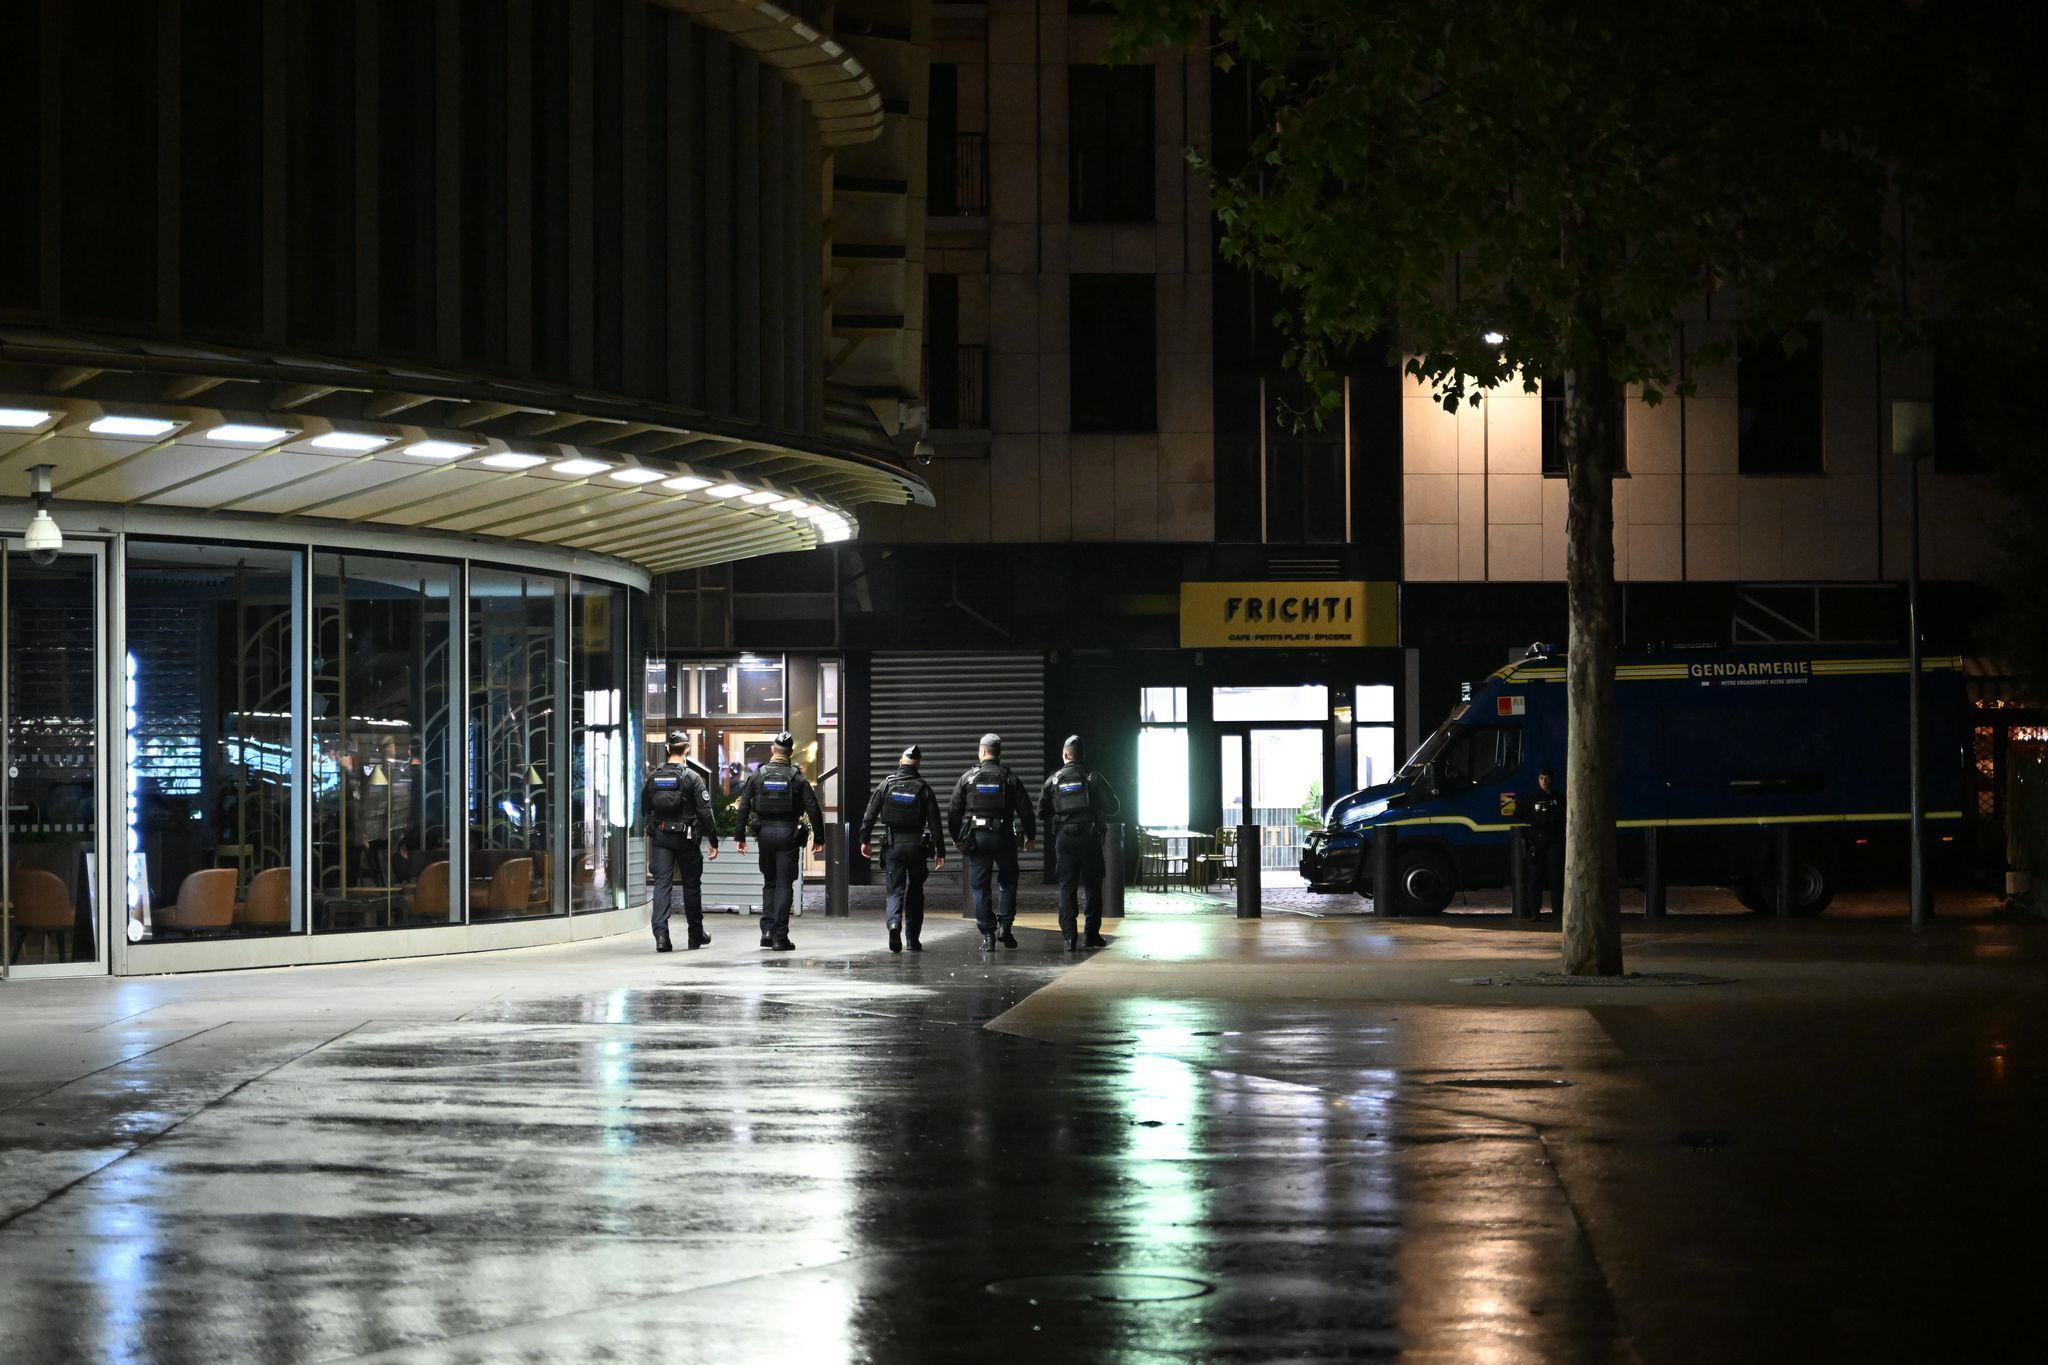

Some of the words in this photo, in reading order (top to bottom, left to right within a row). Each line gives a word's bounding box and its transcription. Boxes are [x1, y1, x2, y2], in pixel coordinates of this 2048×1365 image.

[1225, 597, 1352, 623] FRICHTI
[1254, 633, 1283, 641] PETITS
[1284, 633, 1310, 641] PLATS
[1314, 633, 1352, 641] EPICERIE
[1690, 661, 1809, 677] GENDARMERIE
